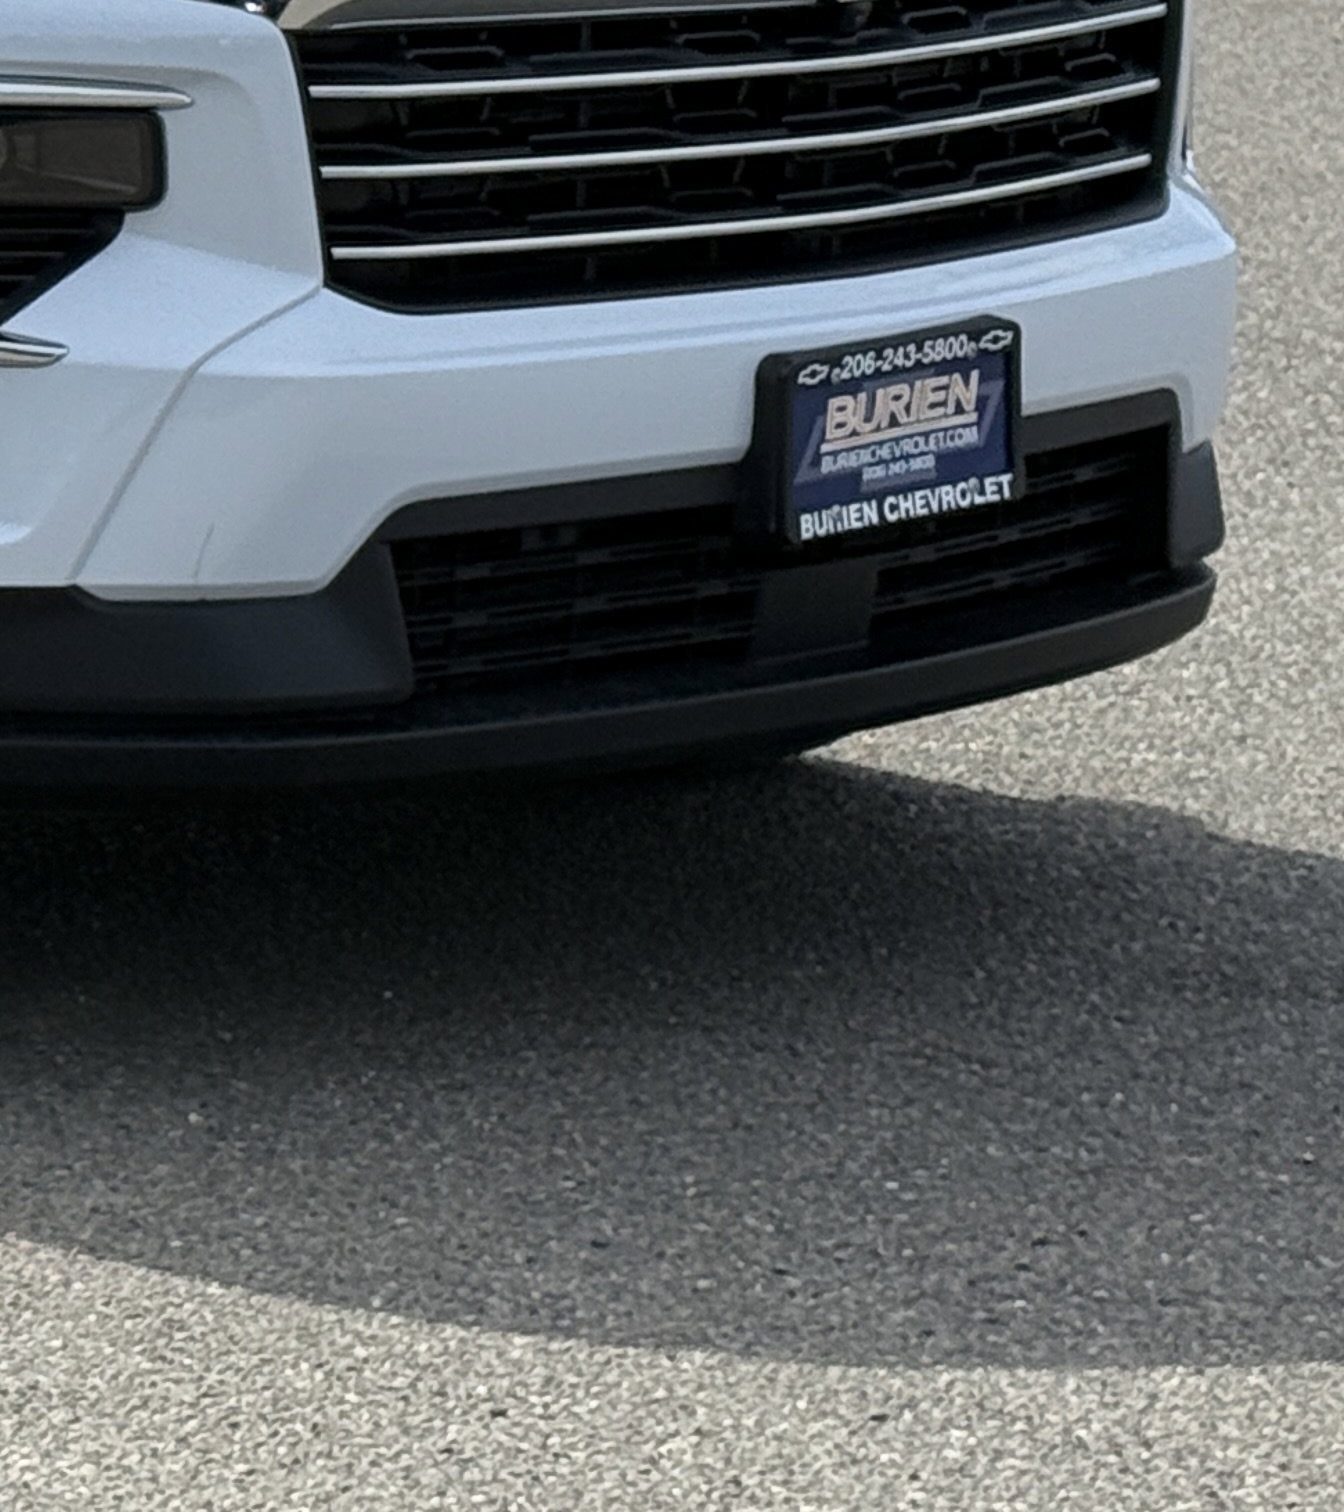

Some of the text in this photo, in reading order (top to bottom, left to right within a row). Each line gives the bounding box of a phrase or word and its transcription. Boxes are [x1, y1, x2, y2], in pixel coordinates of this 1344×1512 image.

[839, 334, 968, 380] 206-243-5800
[824, 369, 979, 439] BURIEN
[800, 473, 1014, 540] BURIEN CHEVROLET
